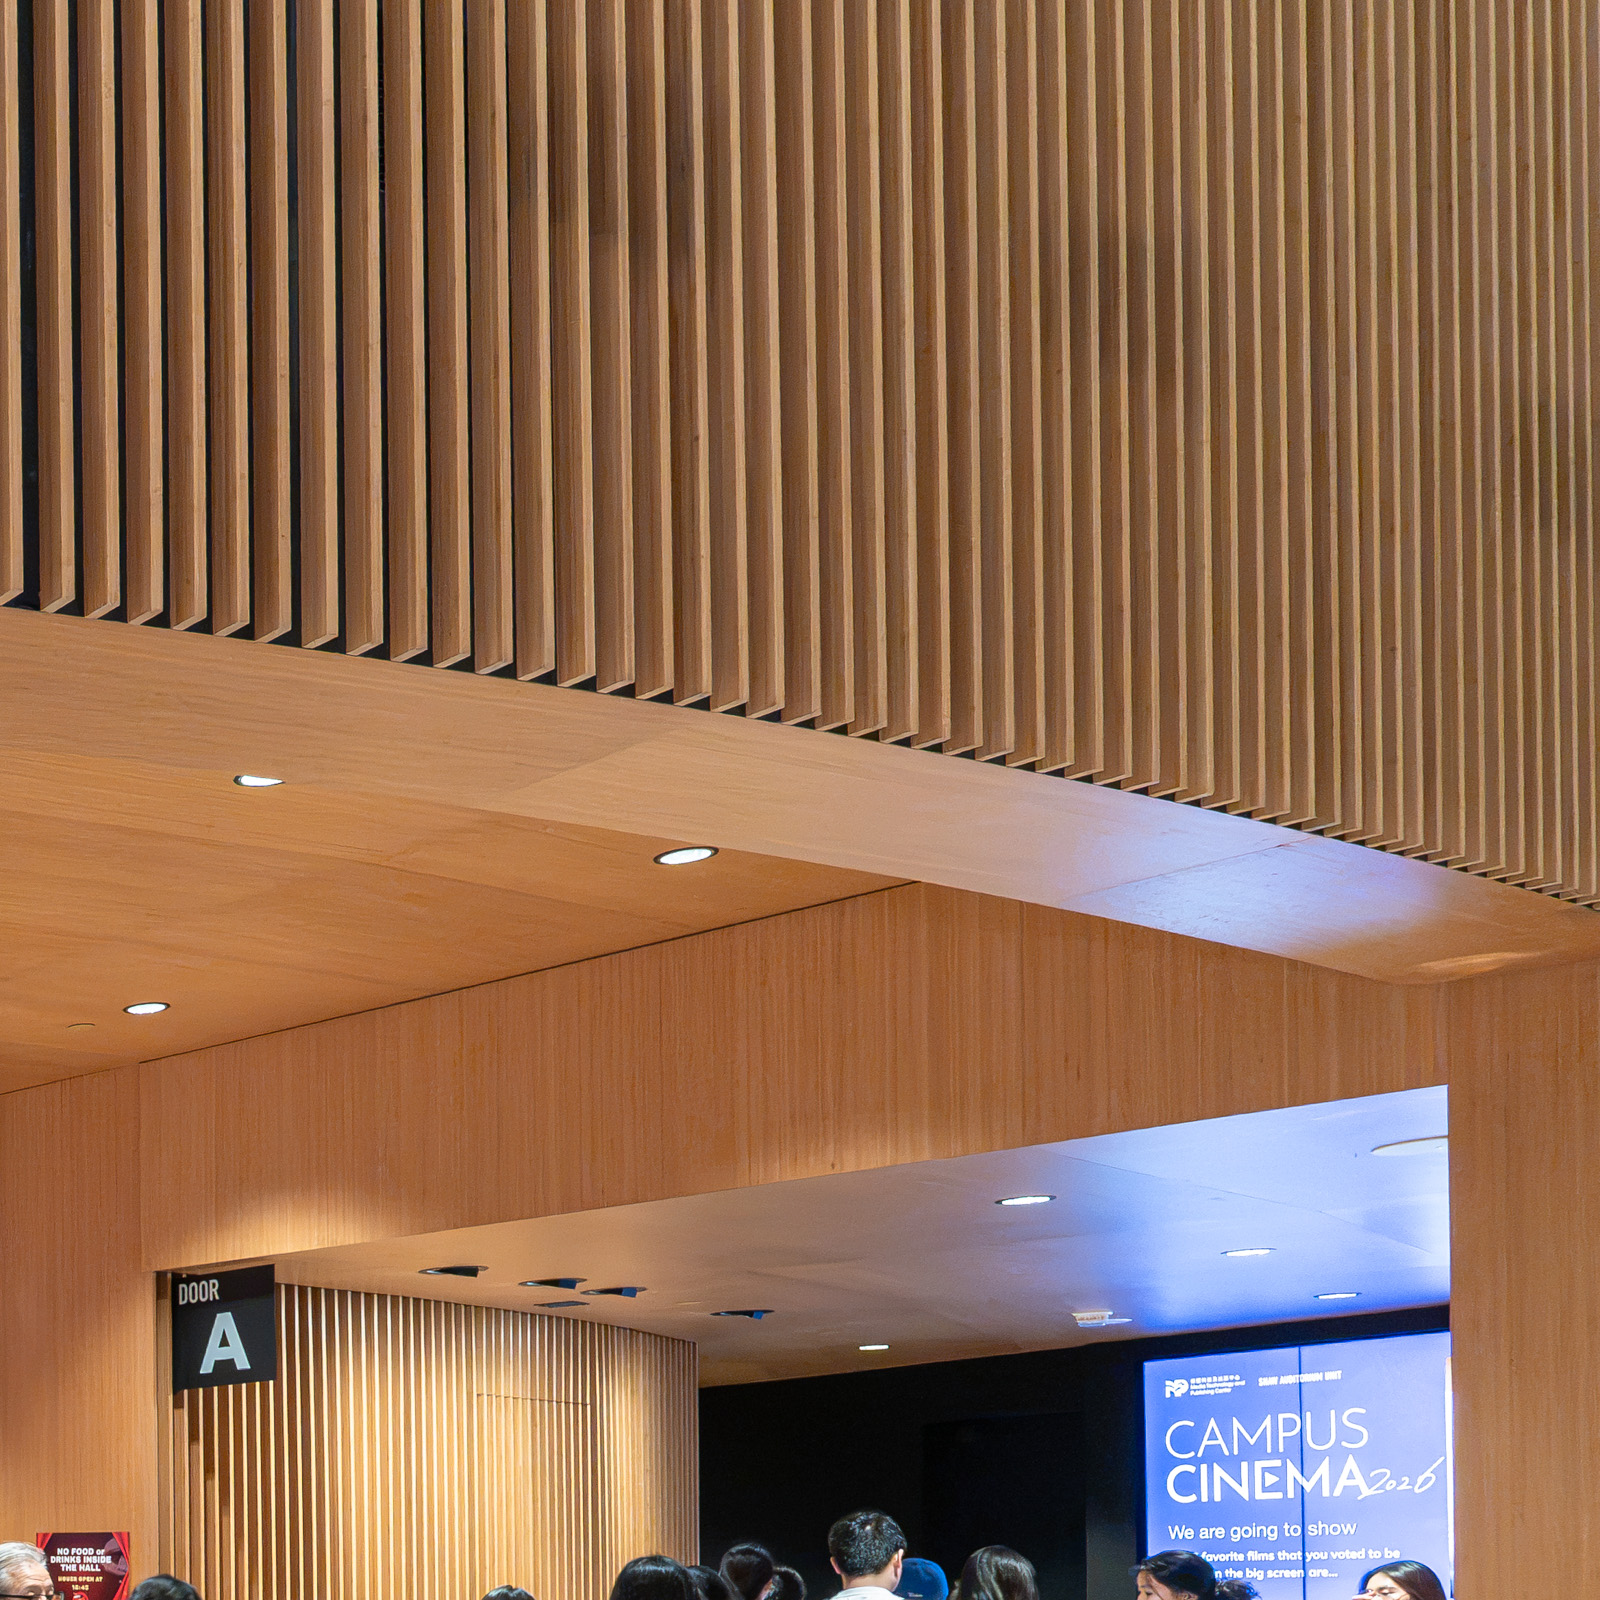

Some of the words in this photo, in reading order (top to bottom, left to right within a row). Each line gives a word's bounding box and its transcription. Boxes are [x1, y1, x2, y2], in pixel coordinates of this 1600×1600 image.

[178, 1278, 220, 1306] DOOR
[199, 1311, 251, 1374] A
[1165, 1407, 1369, 1459] CAMPUS
[1166, 1453, 1370, 1504] CINEMA
[1357, 1456, 1446, 1501] 2026
[1168, 1525, 1194, 1540] We
[1199, 1526, 1225, 1539] are
[1230, 1521, 1279, 1543] going
[1283, 1522, 1302, 1537] to
[1307, 1520, 1358, 1536] show
[50, 1555, 82, 1564] DRINKS
[83, 1555, 112, 1564] INSIDE
[56, 1547, 70, 1556] NO
[71, 1547, 94, 1555] FOOD
[1201, 1550, 1245, 1562] favorite
[1246, 1550, 1275, 1562] films
[1277, 1549, 1303, 1561] that
[1305, 1551, 1329, 1564] you
[1330, 1548, 1366, 1561] voted
[1368, 1548, 1382, 1560] to
[1384, 1548, 1401, 1559] be
[60, 1563, 77, 1572] THE
[79, 1563, 102, 1572] HALL
[1215, 1569, 1223, 1578] n
[1224, 1567, 1243, 1579] the
[1245, 1567, 1265, 1581] big
[1266, 1568, 1305, 1578] screen
[1308, 1568, 1339, 1578] are...
